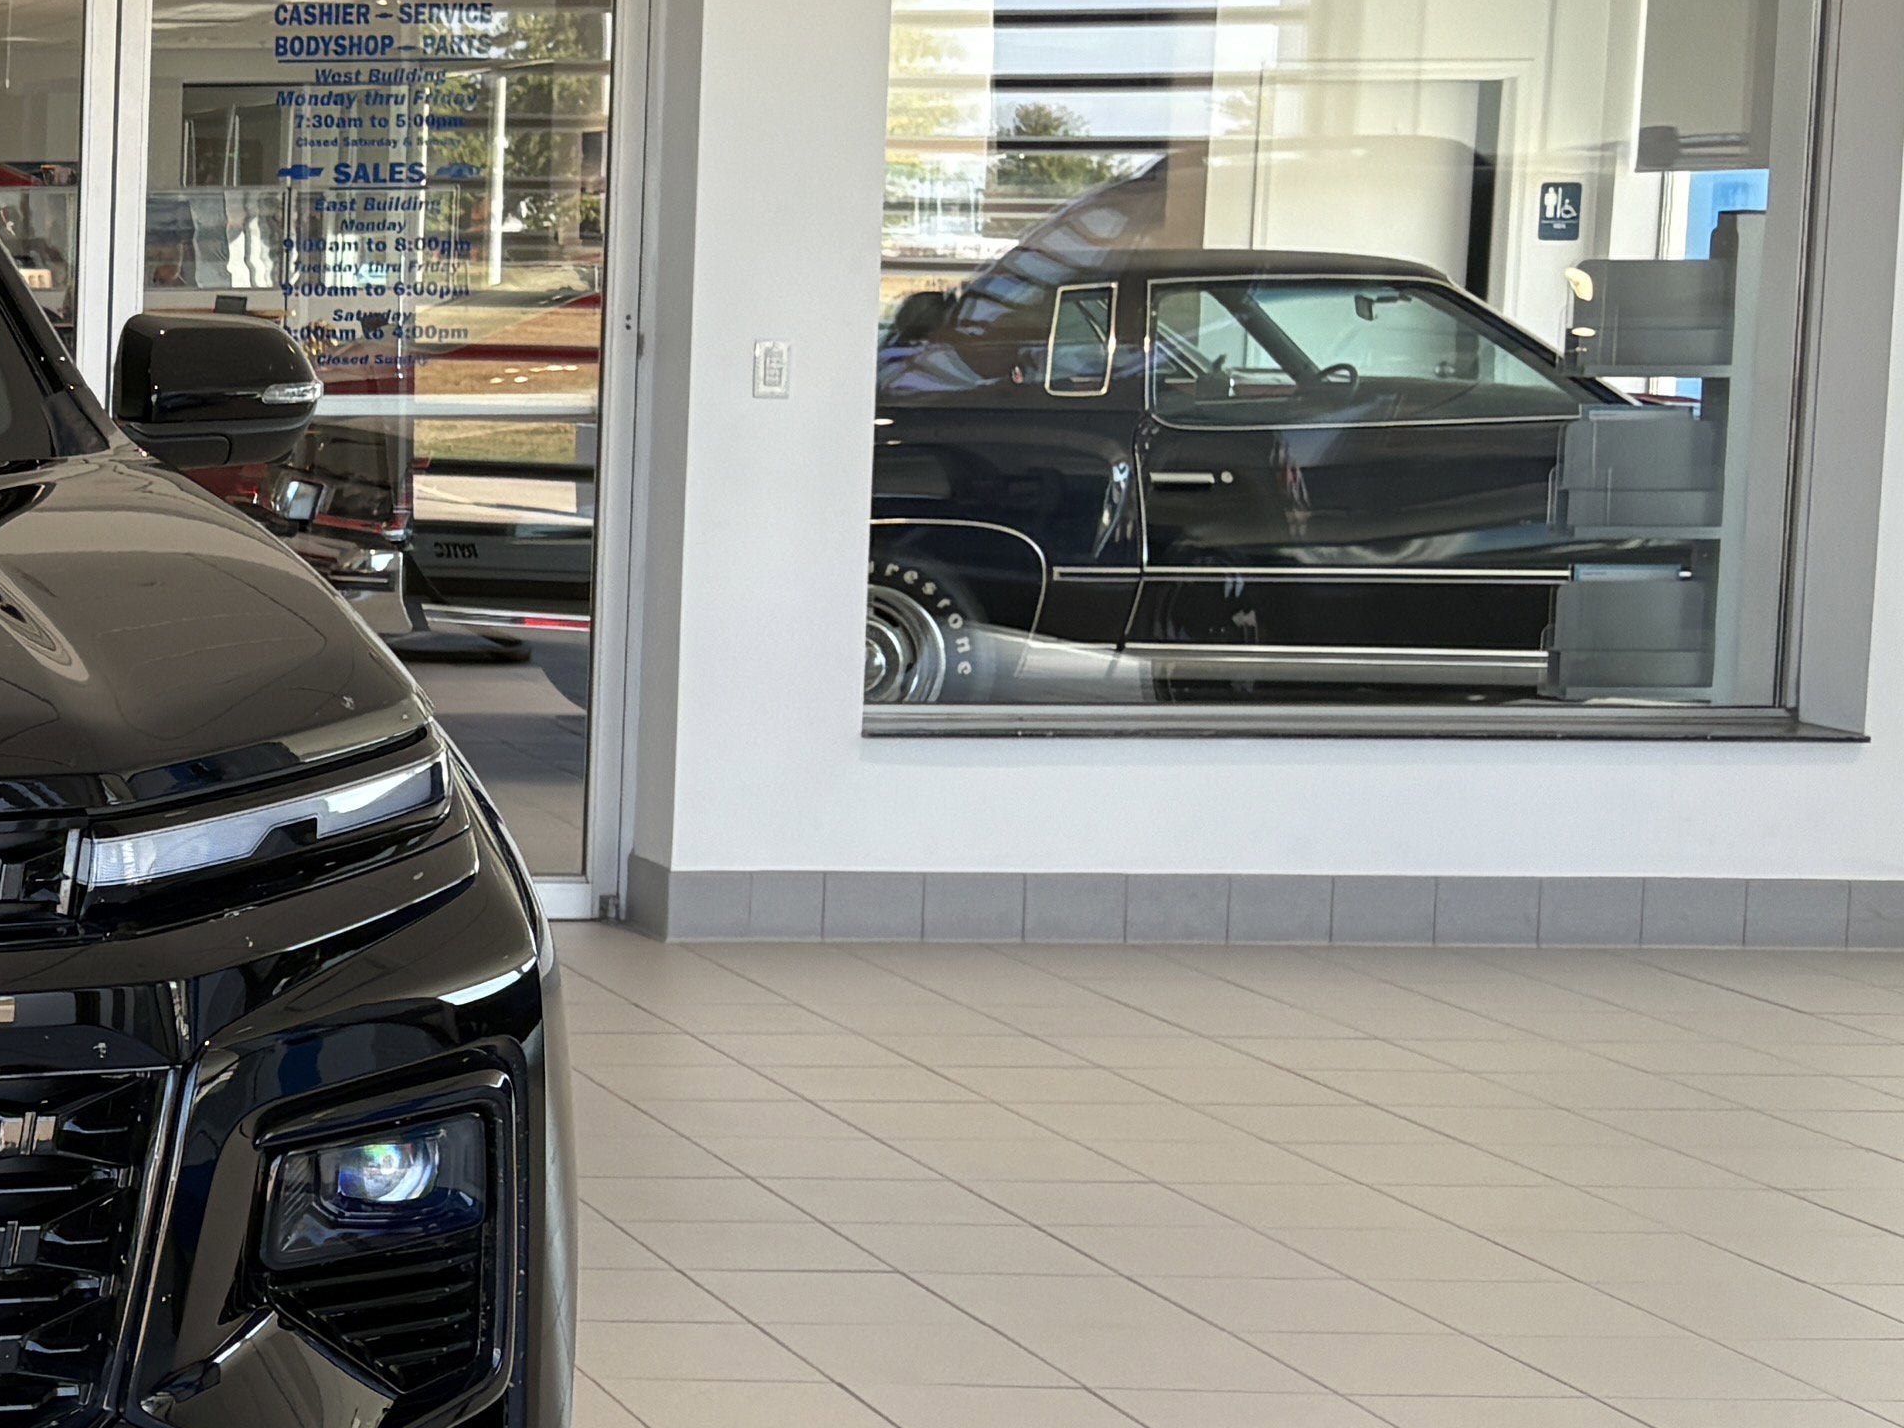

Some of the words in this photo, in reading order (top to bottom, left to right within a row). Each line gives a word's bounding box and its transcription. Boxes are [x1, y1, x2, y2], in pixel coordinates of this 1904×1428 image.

[275, 3, 371, 26] CASHIER
[399, 3, 493, 25] SERVICE
[275, 35, 394, 57] BODYSHOP
[423, 34, 493, 55] PARTS
[315, 68, 361, 84] West
[368, 68, 447, 86] Building
[276, 91, 358, 109] Monday
[365, 91, 406, 107] thru
[413, 91, 478, 109] Friday
[295, 114, 363, 129] 7:30am
[370, 115, 389, 129] to
[396, 114, 465, 132] 5:00pm
[296, 137, 338, 149] Closed
[343, 137, 398, 150] Saturday
[333, 162, 427, 185] SALES
[315, 197, 357, 212] East
[363, 196, 441, 214] Building
[340, 219, 407, 234] Monday
[282, 237, 359, 252] 9:00am
[367, 238, 386, 252] to
[395, 237, 471, 255] 8:00pm
[295, 260, 360, 275] Tuesday
[368, 260, 401, 273] thru
[408, 260, 460, 274] Friday
[282, 283, 358, 297] 9:00am
[365, 283, 386, 297] to
[393, 282, 470, 299] 6:00pm
[333, 309, 413, 323] Saturday
[363, 327, 385, 341] to
[392, 325, 469, 342] 4:00pm
[317, 354, 369, 366] Closed
